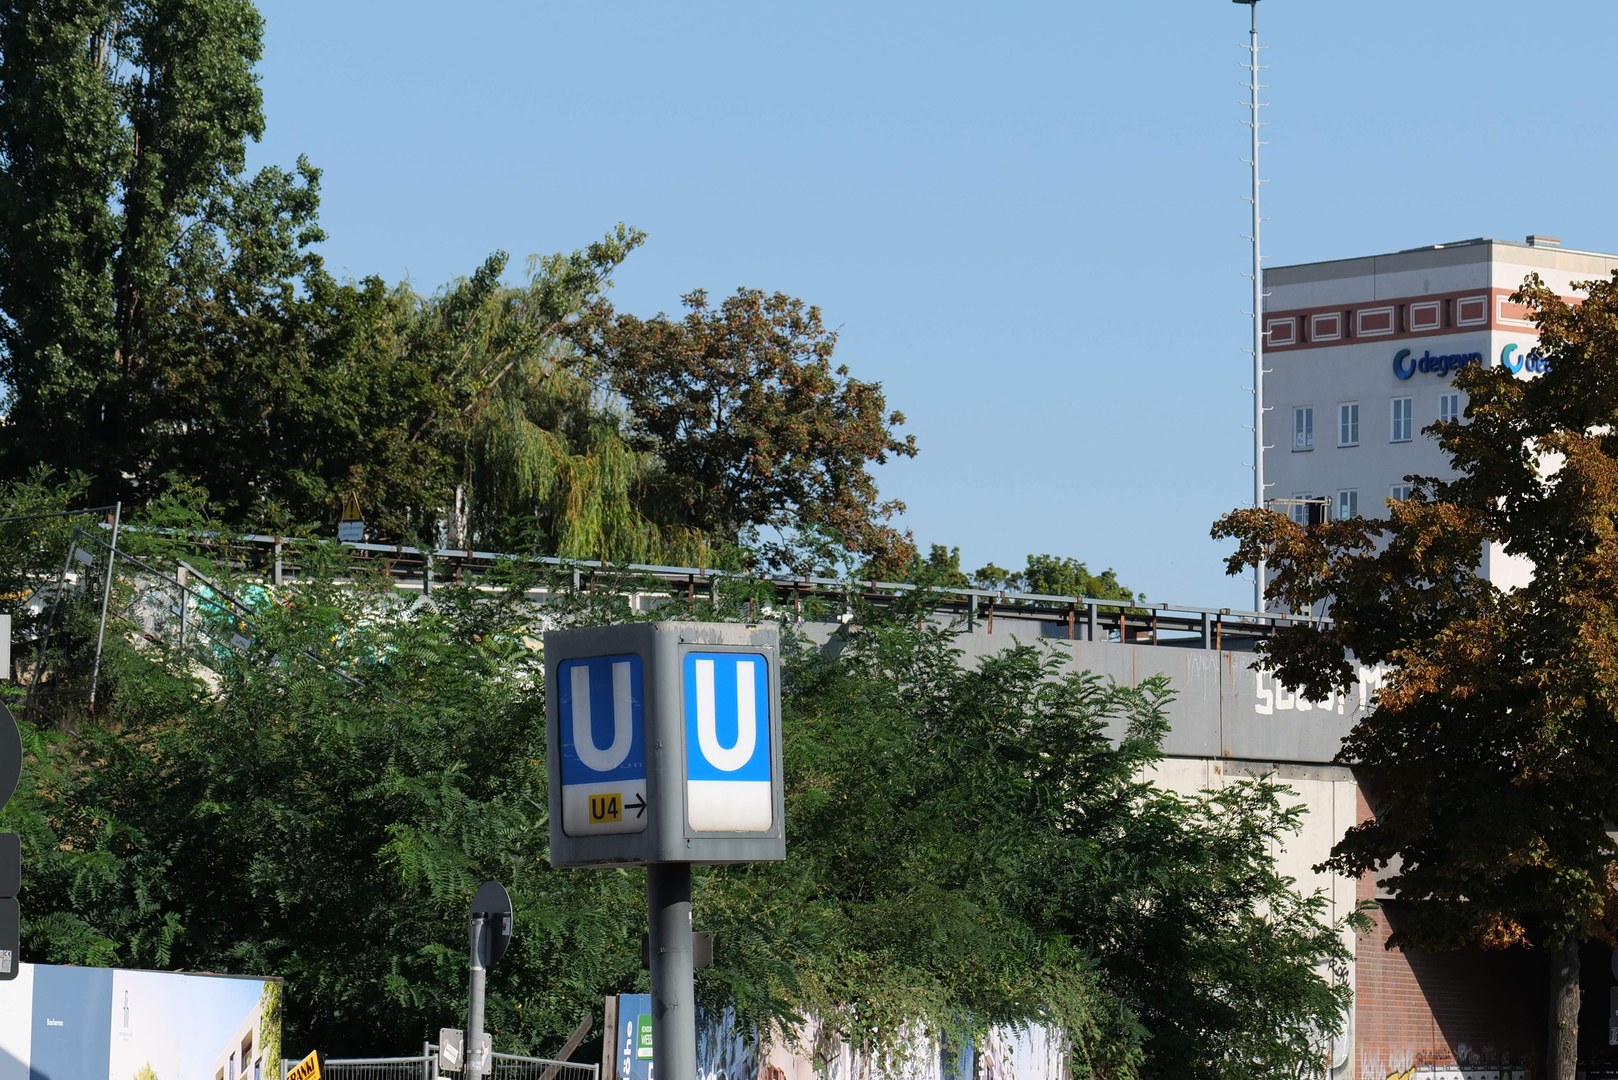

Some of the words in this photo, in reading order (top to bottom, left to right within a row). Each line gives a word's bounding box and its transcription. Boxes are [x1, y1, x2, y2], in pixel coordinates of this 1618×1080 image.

[570, 661, 633, 772] U
[695, 659, 757, 772] U
[591, 796, 619, 820] U4
